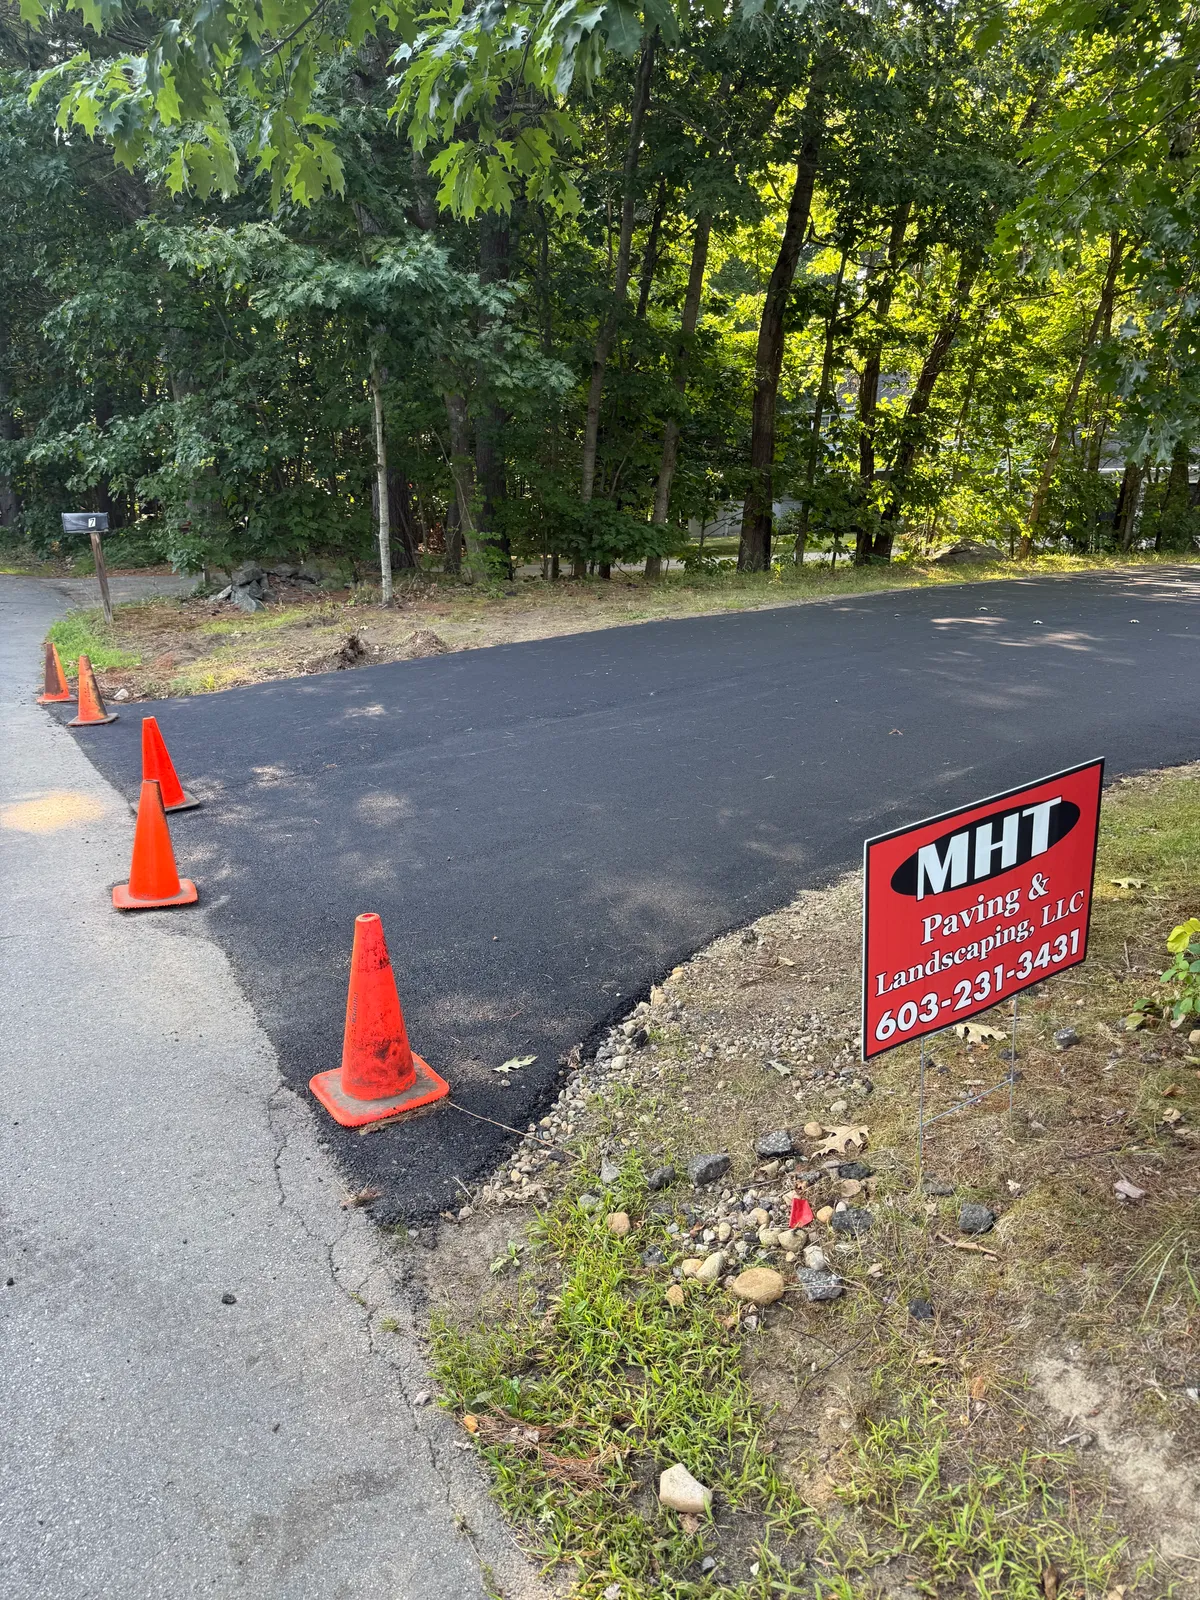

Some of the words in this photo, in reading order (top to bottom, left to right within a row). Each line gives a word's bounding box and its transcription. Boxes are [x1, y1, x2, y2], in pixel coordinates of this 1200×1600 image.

[89, 518, 95, 527] 7
[916, 795, 1062, 901] MHT
[875, 919, 1035, 997] Landscaping,
[1040, 890, 1085, 928] LLC
[921, 887, 1021, 945] Paving
[1028, 872, 1050, 901] &
[874, 928, 1080, 1041] 603-231-3431
